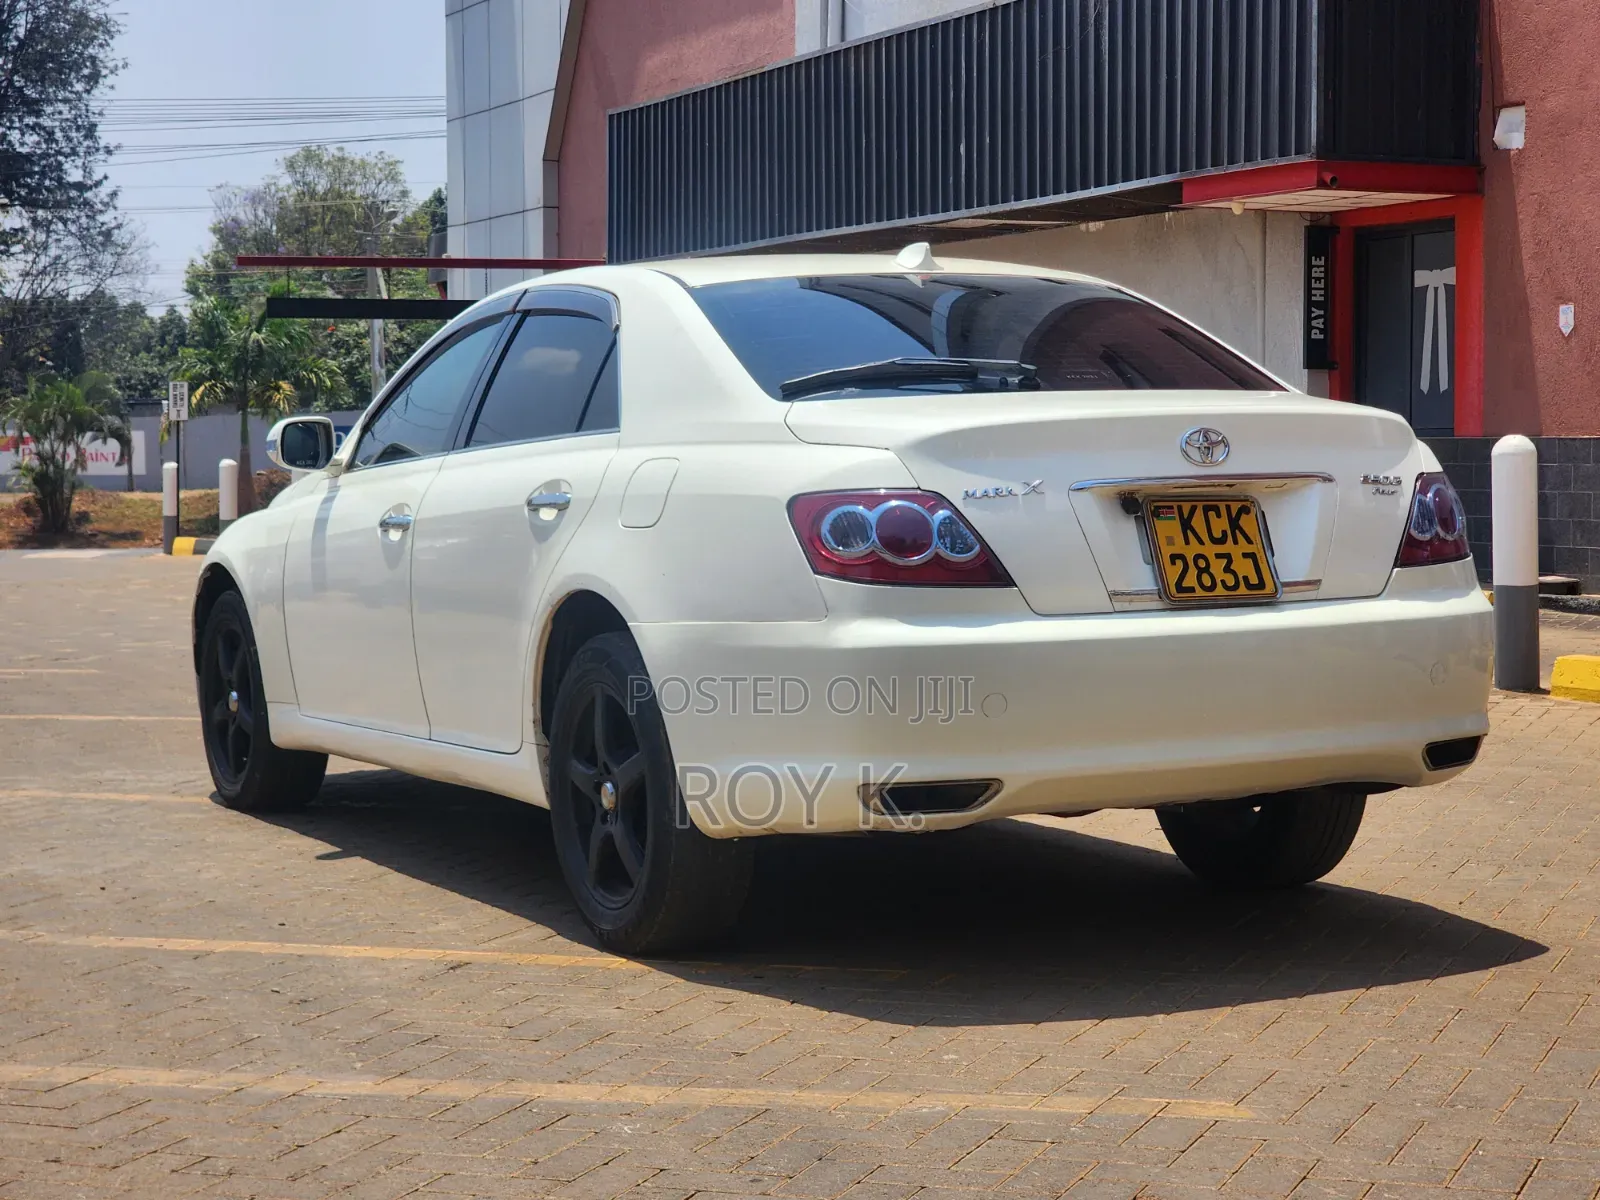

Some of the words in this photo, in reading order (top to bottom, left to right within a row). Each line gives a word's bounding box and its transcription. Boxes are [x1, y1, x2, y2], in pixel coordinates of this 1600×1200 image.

[1312, 256, 1325, 301] HERE
[1311, 307, 1324, 339] PAY
[962, 486, 1018, 500] MARK
[1021, 479, 1045, 496] X
[1177, 504, 1254, 546] KCK
[1169, 552, 1266, 593] 283J
